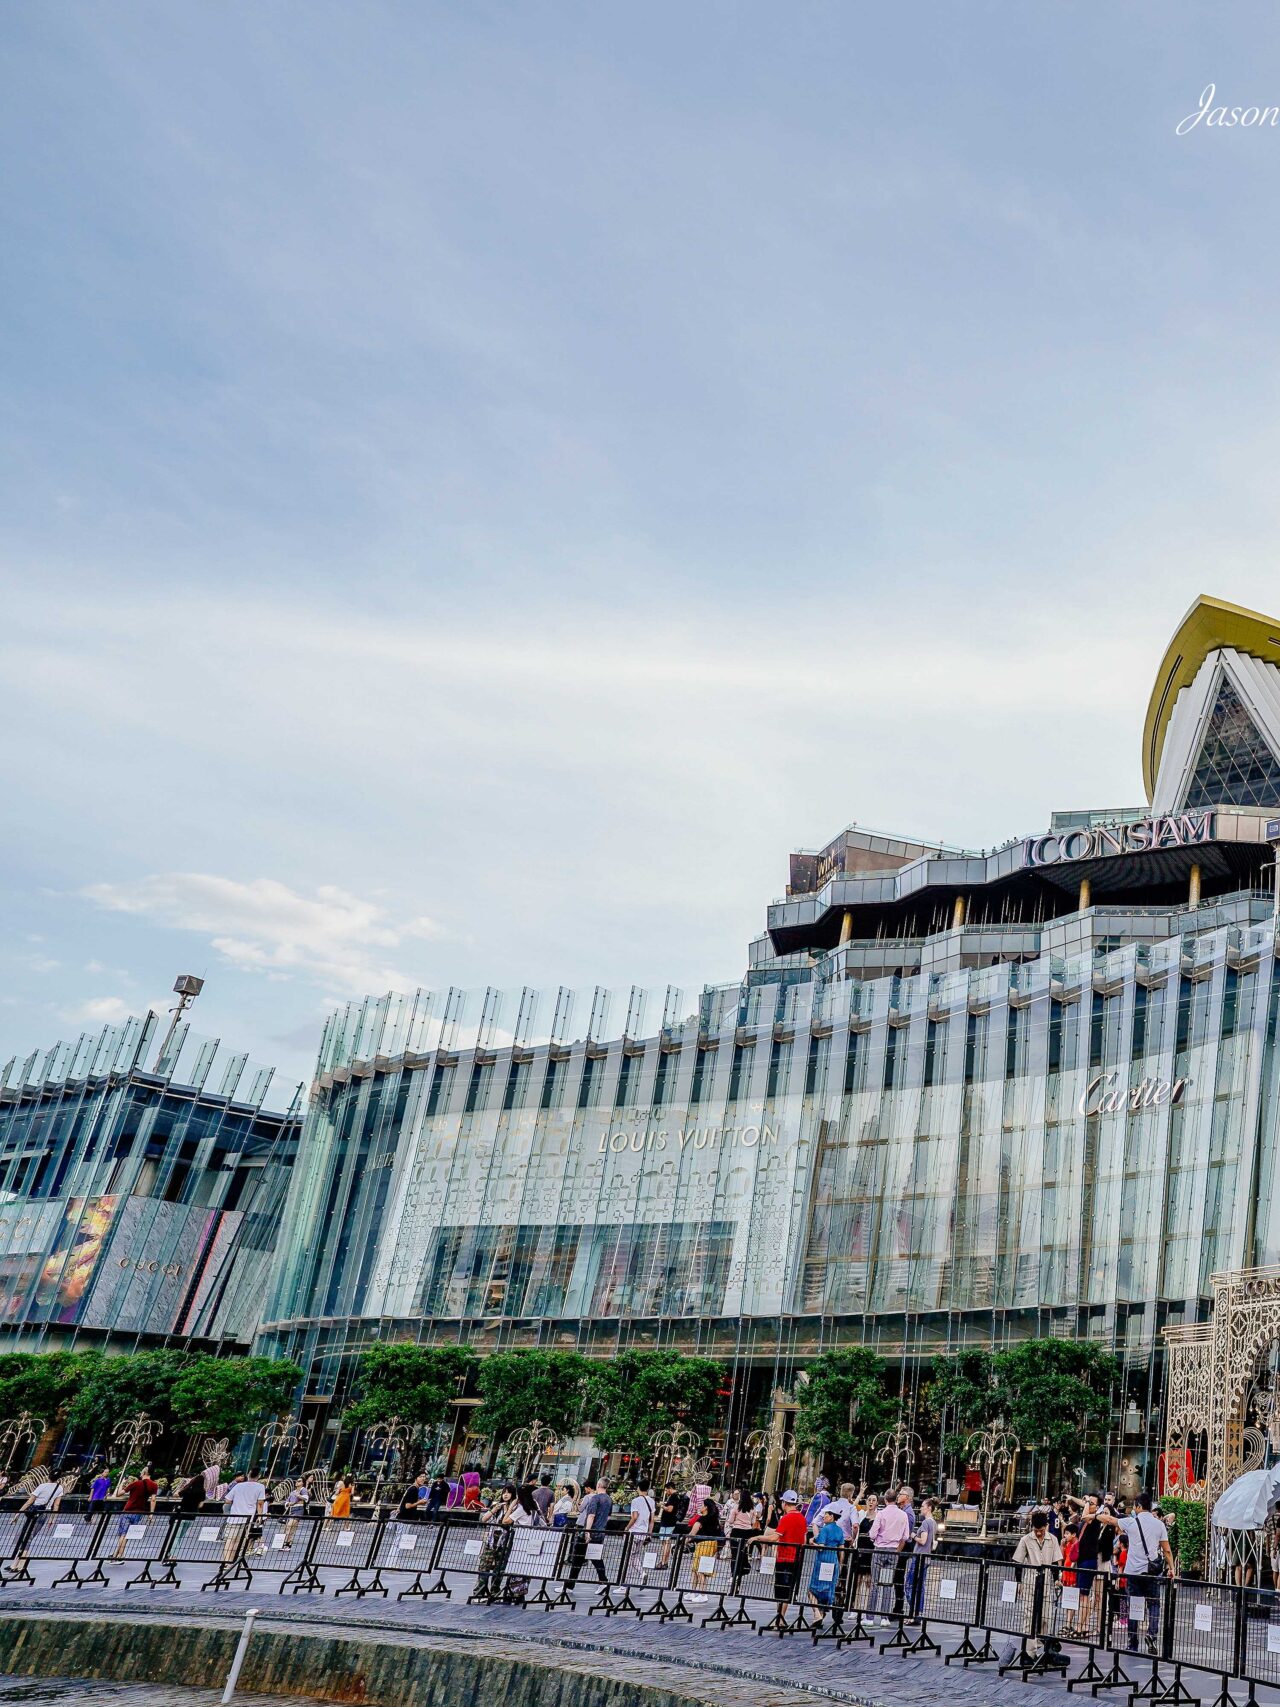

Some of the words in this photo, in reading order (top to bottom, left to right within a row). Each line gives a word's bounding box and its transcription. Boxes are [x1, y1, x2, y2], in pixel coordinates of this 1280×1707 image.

[1021, 811, 1214, 868] ICONSIAM
[1078, 1073, 1192, 1117] Cartier
[598, 1130, 669, 1153] LOUIS
[678, 1124, 781, 1149] VUITTON
